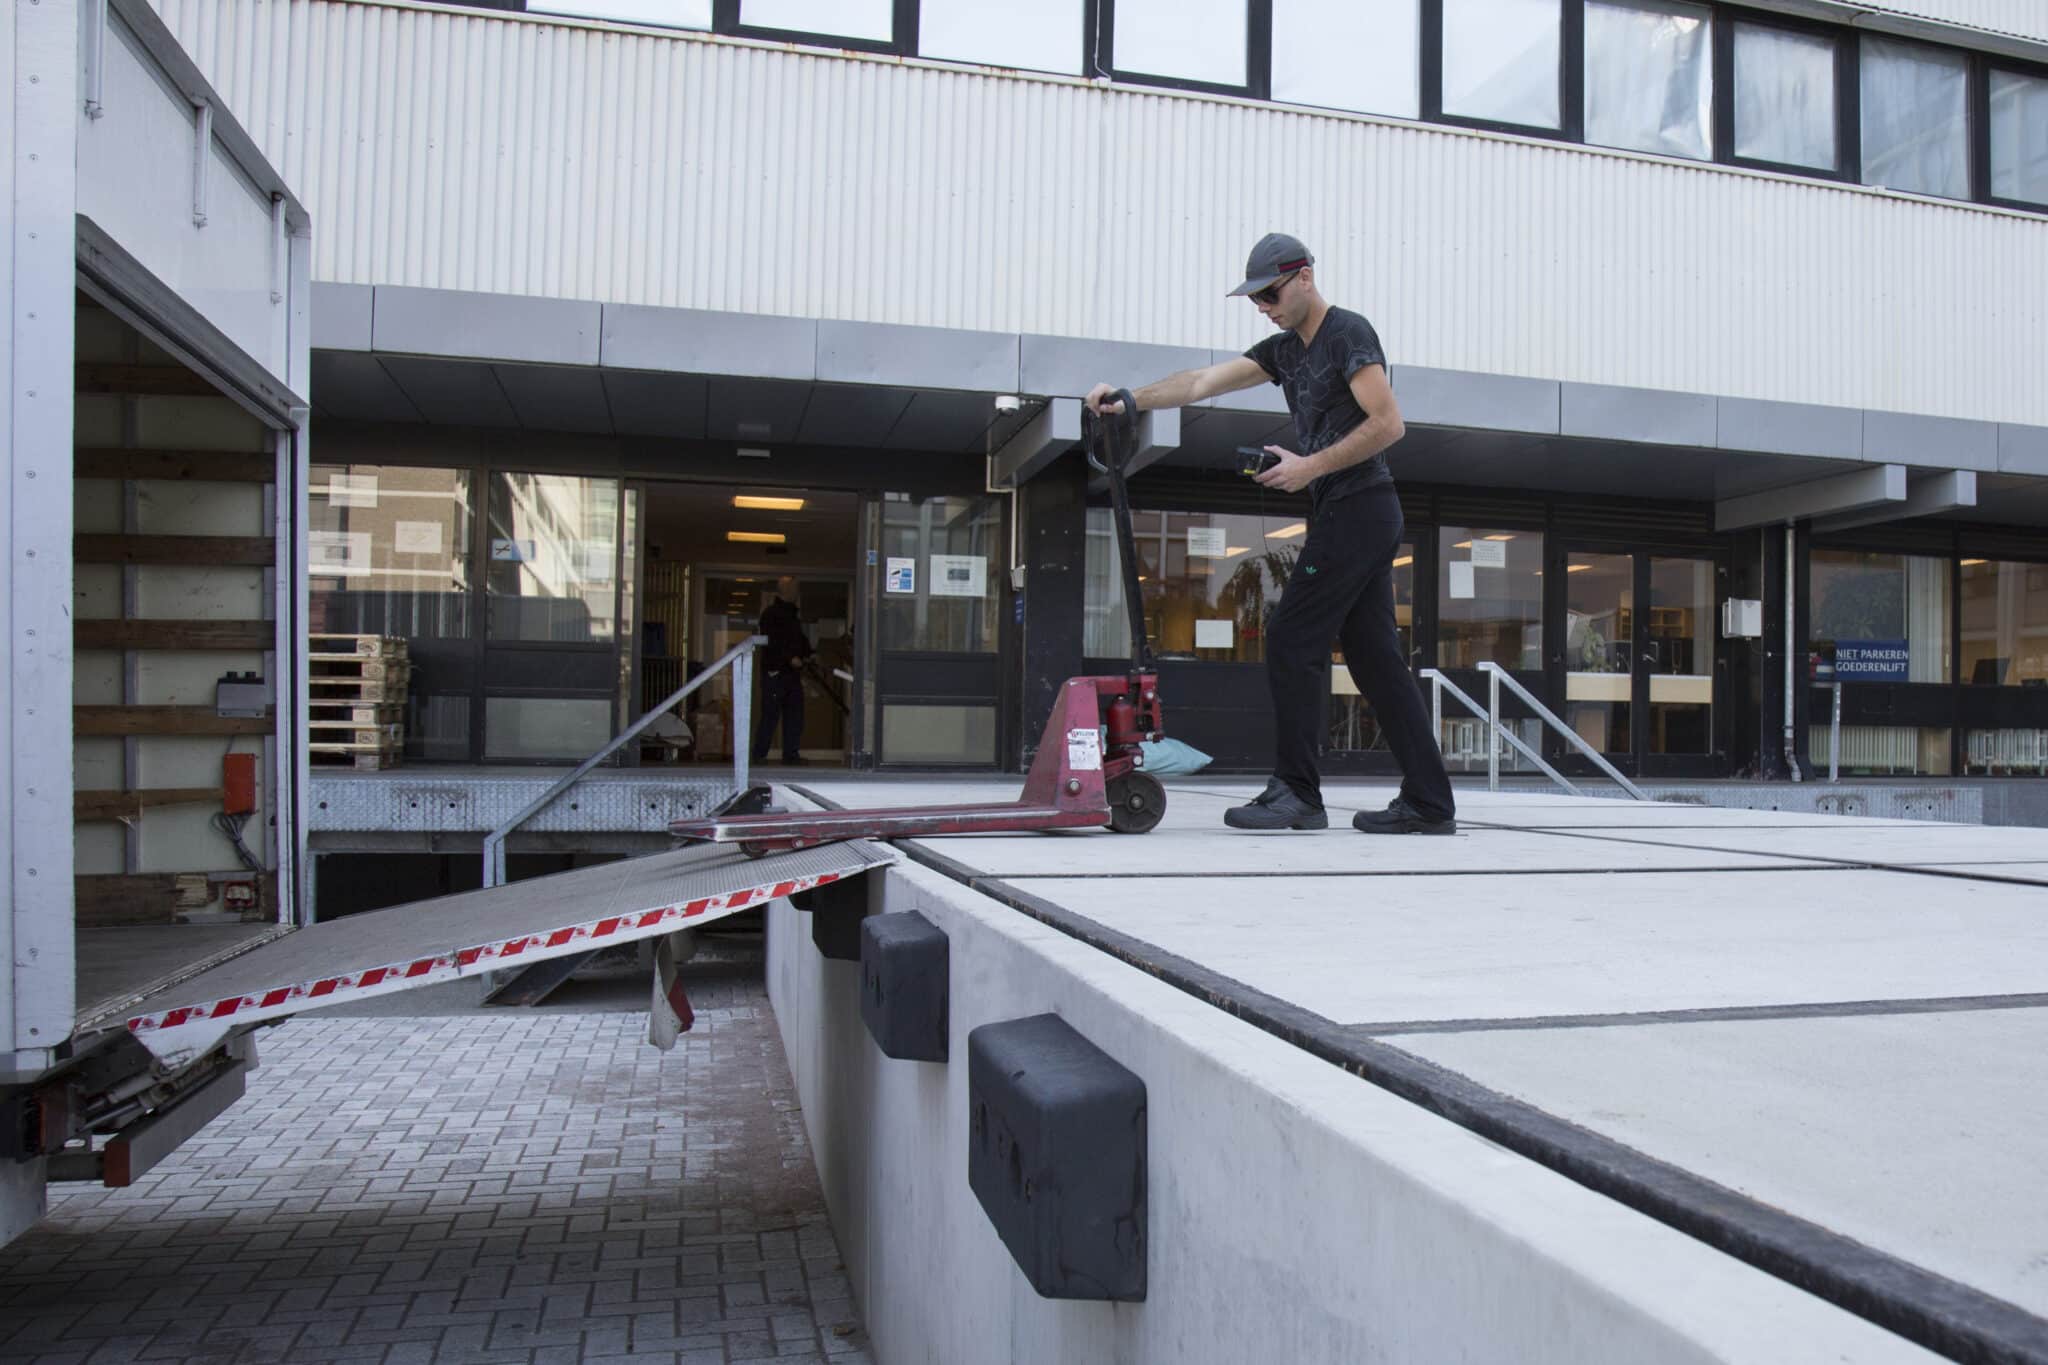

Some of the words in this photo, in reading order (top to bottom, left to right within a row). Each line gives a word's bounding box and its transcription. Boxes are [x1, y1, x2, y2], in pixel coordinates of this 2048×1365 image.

[1836, 649, 1859, 659] NIET
[1860, 649, 1909, 660] PARKEREN
[1836, 662, 1906, 672] GOEDERENLIFT
